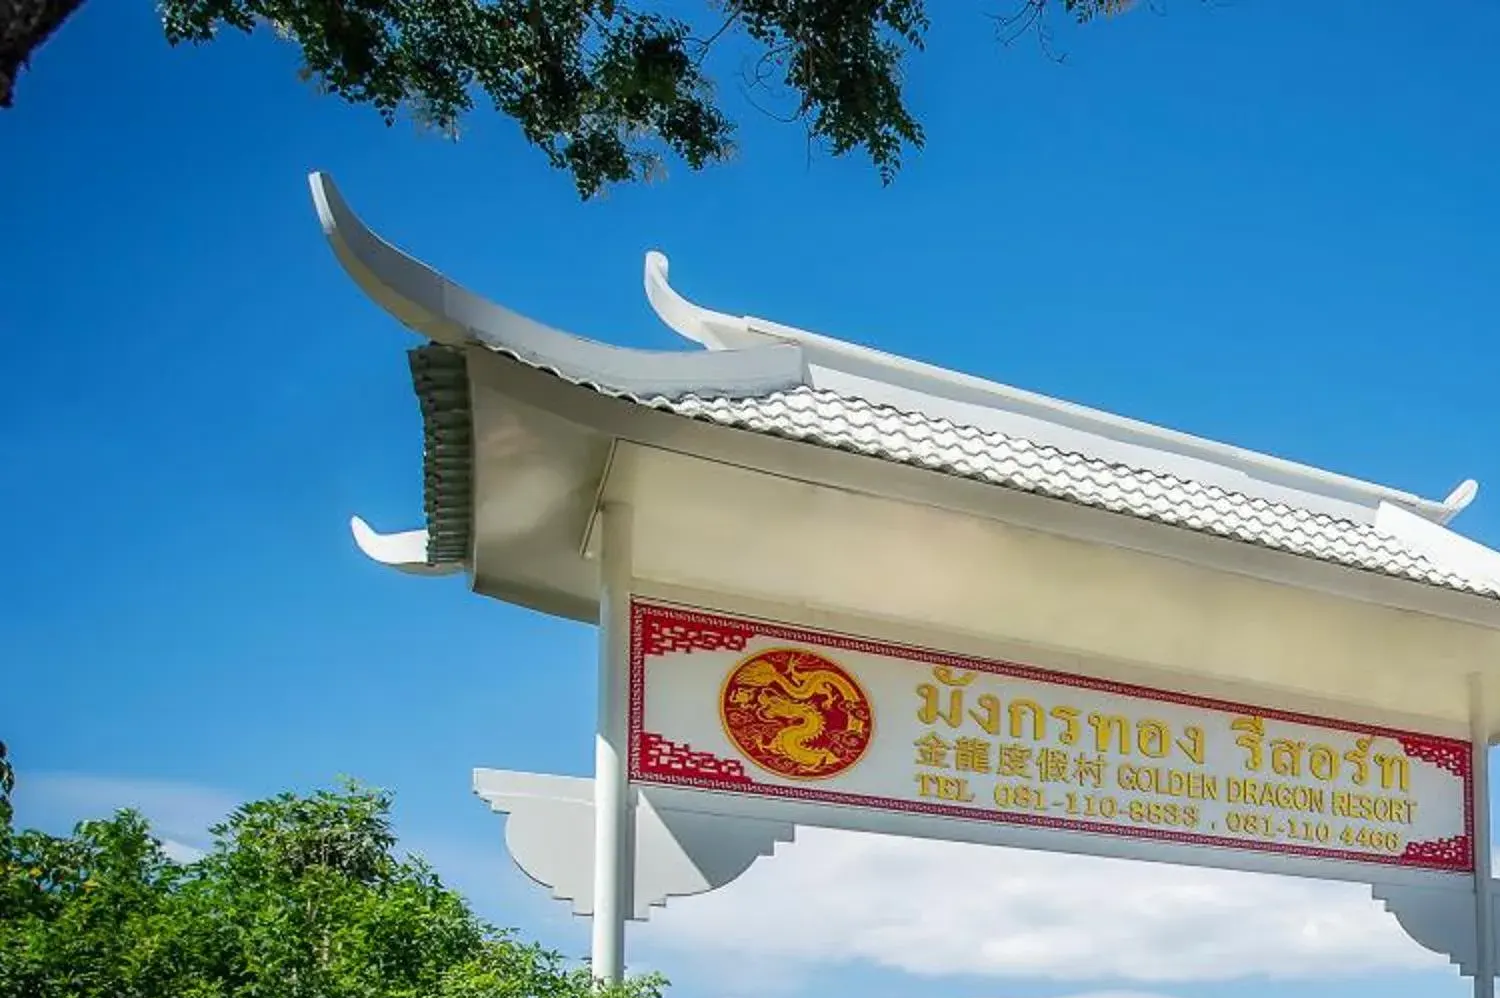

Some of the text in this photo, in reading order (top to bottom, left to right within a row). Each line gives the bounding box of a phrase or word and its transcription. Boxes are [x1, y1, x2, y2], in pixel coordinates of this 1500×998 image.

[916, 666, 1410, 792] มังกรทอง รีสอร์ท
[914, 733, 1417, 825] 金龍度假村 GOLDEN DRAGON RESORT
[914, 772, 975, 802] TEL
